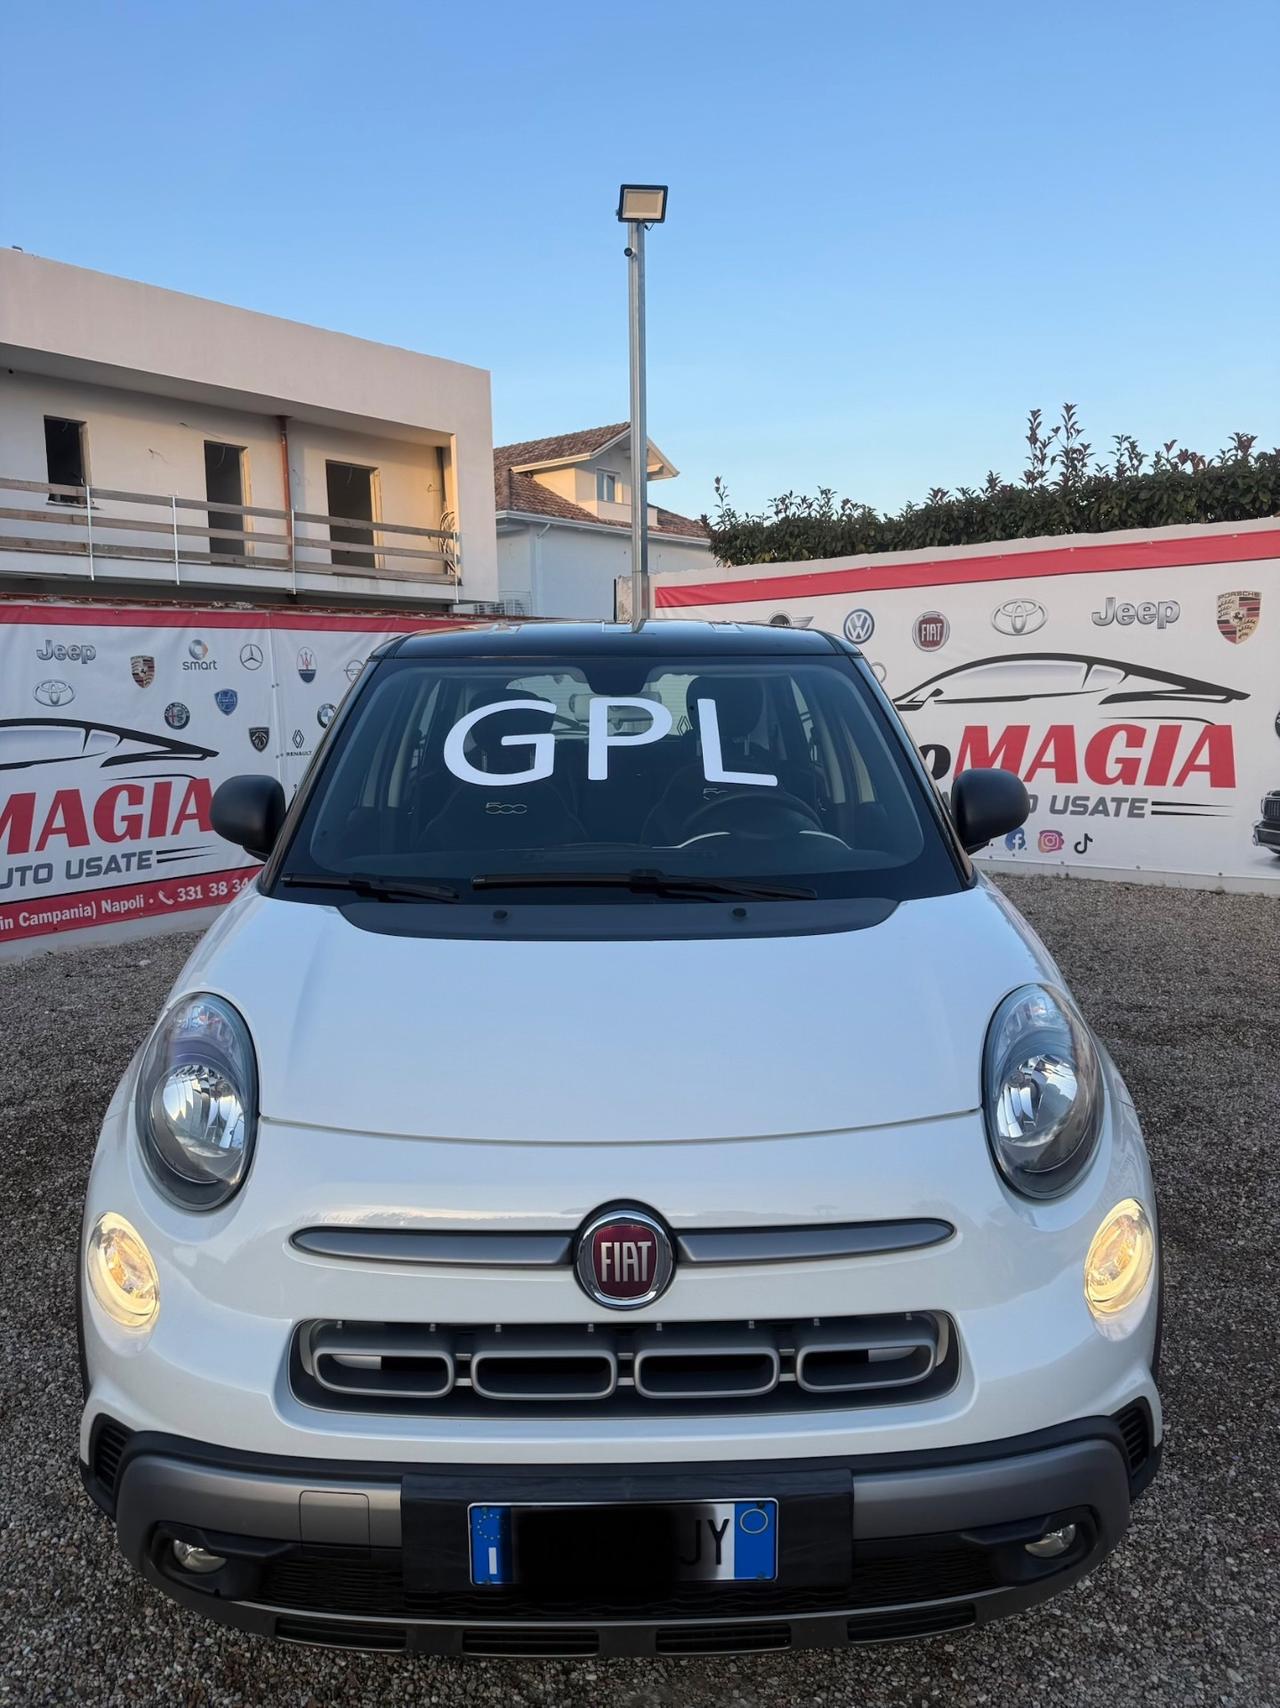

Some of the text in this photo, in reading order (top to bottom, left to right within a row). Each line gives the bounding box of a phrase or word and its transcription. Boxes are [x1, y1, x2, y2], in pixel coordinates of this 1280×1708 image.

[1217, 591, 1263, 601] PORSCHE
[1091, 597, 1181, 629] Jeep
[921, 622, 944, 642] FIAT
[36, 640, 97, 664] Jeep
[182, 659, 219, 672] smart
[443, 697, 779, 787] GPL
[1049, 794, 1149, 818] USATE
[65, 850, 153, 880] USATE
[19, 901, 97, 926] Campania)
[101, 894, 145, 915] Napoli
[177, 884, 203, 902] 331
[208, 881, 228, 897] 38
[600, 1241, 652, 1282] FIAT
